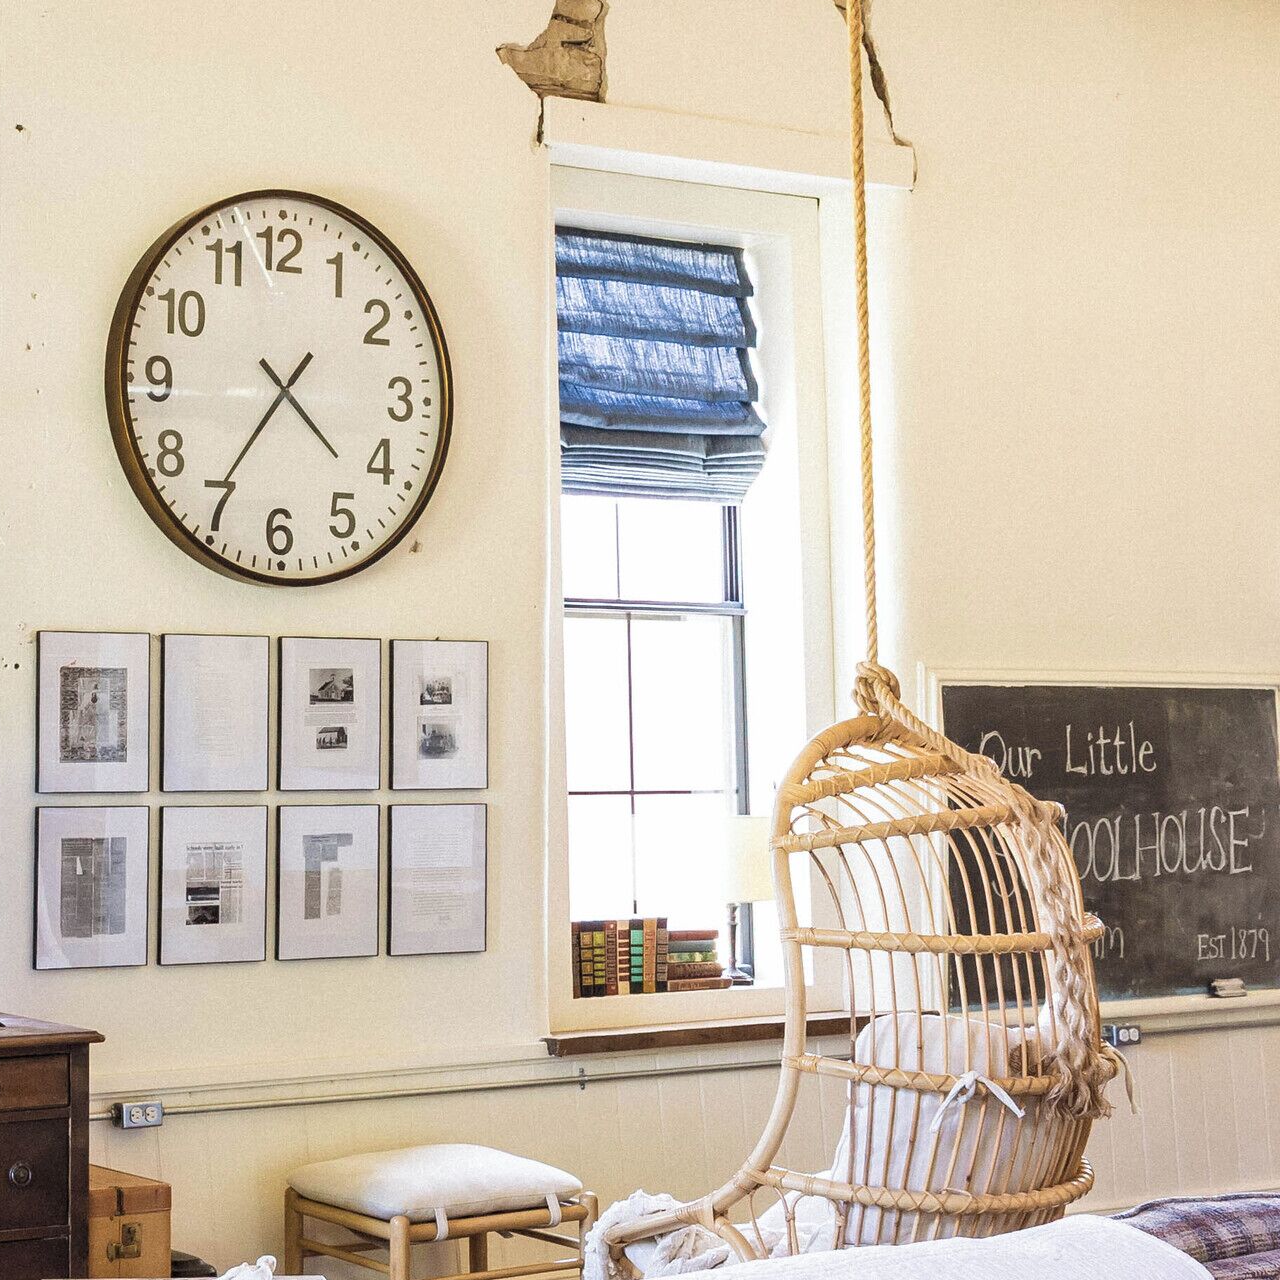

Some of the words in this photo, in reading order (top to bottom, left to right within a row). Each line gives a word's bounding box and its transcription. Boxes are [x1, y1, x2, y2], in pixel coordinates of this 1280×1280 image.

[205, 238, 242, 287] 11
[256, 225, 303, 274] 12
[326, 252, 343, 298] 1
[158, 288, 205, 337] 10
[363, 299, 391, 346] 2
[145, 355, 173, 402] 9
[387, 376, 413, 422] 3
[156, 429, 184, 477] 8
[367, 438, 395, 485] 4
[204, 480, 236, 531] 7
[329, 493, 356, 539] 5
[266, 508, 294, 555] 6
[979, 731, 1041, 778] Our
[1065, 721, 1157, 776] Little
[989, 806, 1253, 898] OOLHOUSE
[1231, 927, 1270, 962] 1879
